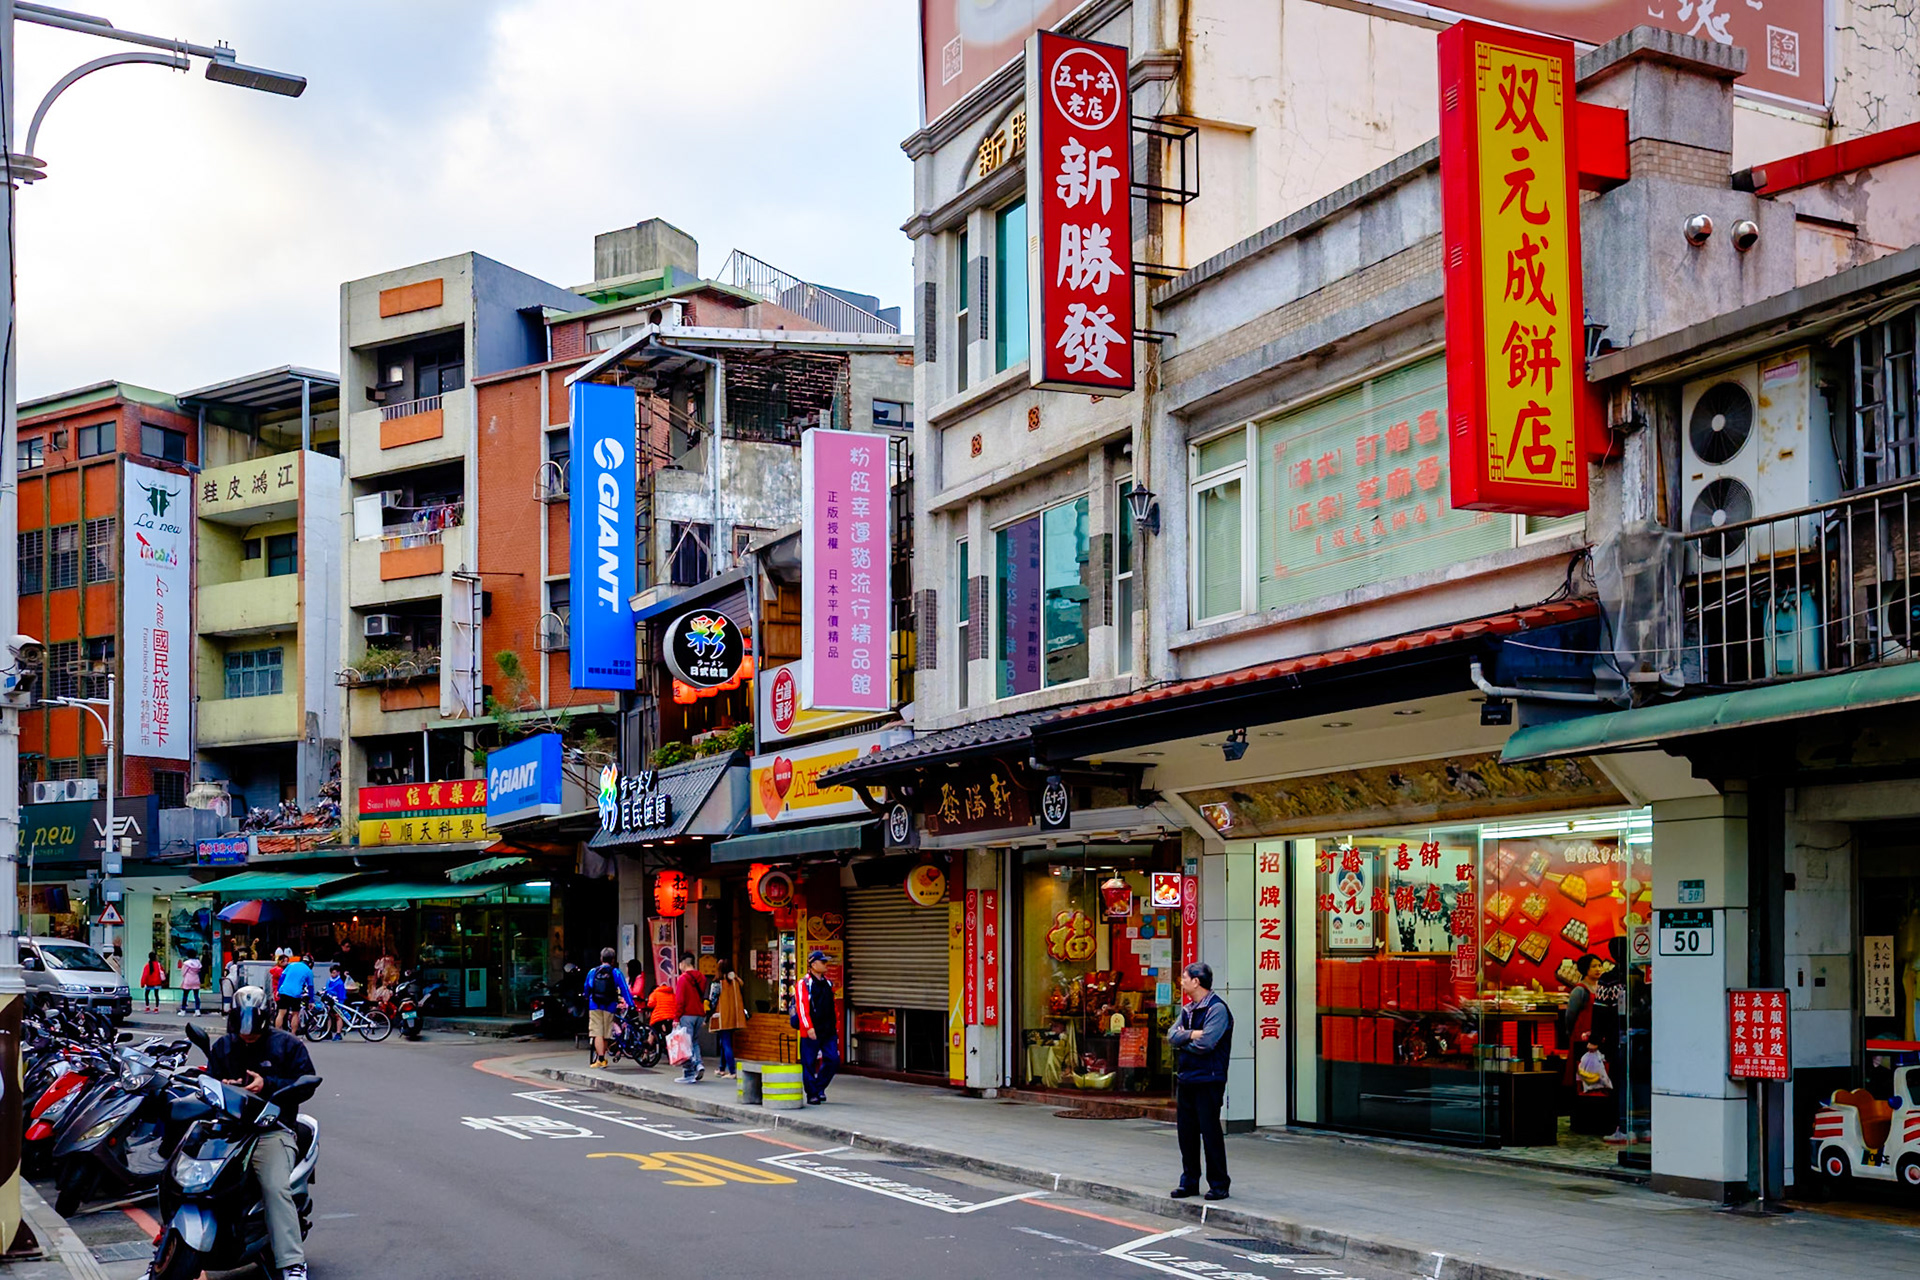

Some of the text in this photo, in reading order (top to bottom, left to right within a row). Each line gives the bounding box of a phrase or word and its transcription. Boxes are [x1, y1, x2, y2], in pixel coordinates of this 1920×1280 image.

[1056, 65, 1114, 97] 五十年
[1067, 97, 1104, 121] 老店
[1055, 136, 1126, 379] 新勝發
[1494, 62, 1561, 476] 双元成餅店
[1356, 408, 1448, 467] 訂婚喜
[1356, 455, 1449, 510] 芝麻蛋
[133, 512, 182, 534] La new
[597, 473, 620, 614] GIANT
[156, 574, 169, 598] La
[827, 491, 839, 659] 正版授權 日本平價精品
[685, 615, 728, 660] 彩
[697, 659, 724, 668] ラーメン
[152, 628, 170, 748] 國民旅遊卡
[500, 760, 538, 796] GIANT
[1044, 789, 1066, 804] 五十年
[937, 773, 1014, 825] 新勝發
[1047, 805, 1062, 819] 老店
[34, 826, 76, 846] new
[892, 813, 907, 826] 五十年
[1319, 883, 1443, 915] 双元成餅店
[1687, 889, 1701, 901] 50
[1047, 909, 1097, 962] 福
[1259, 850, 1282, 1041] 招牌芝麻蛋黃
[1674, 930, 1700, 952] 50
[1733, 992, 1748, 1056] 拉鍊更換
[1751, 992, 1766, 1057] 衣服訂製
[1769, 993, 1785, 1057] 衣服修改
[585, 1151, 798, 1187] 30
